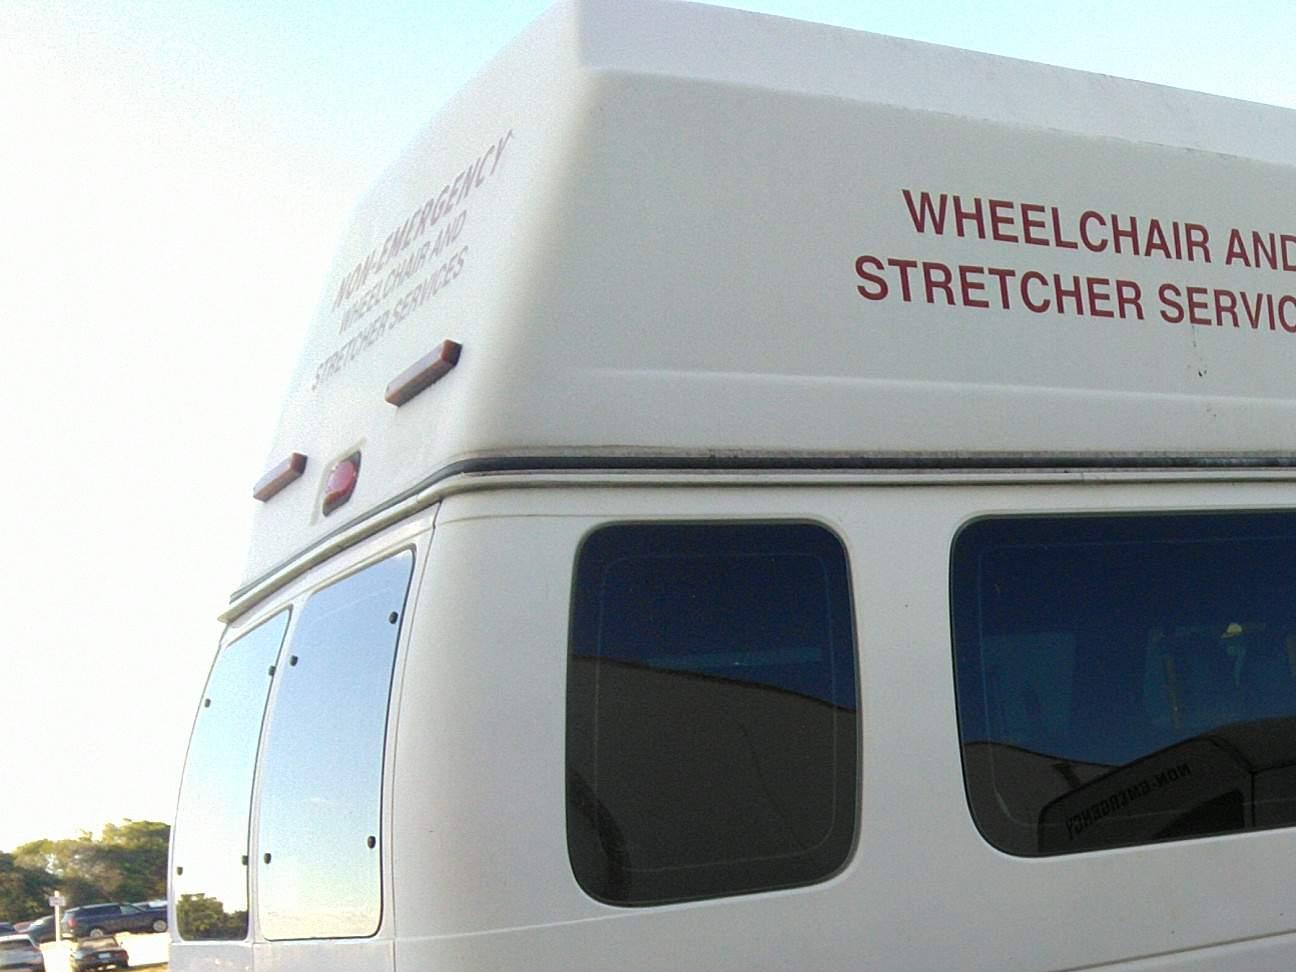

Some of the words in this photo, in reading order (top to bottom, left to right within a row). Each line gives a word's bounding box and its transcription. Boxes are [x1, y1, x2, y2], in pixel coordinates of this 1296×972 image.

[332, 129, 512, 313] NON-EMERGENCY
[901, 189, 1211, 263] WHEELCHAIR
[339, 241, 431, 335] WHEELCHAIR
[429, 210, 466, 260] AND
[389, 245, 468, 330] SERVICES
[855, 255, 1144, 320] STRETCHER
